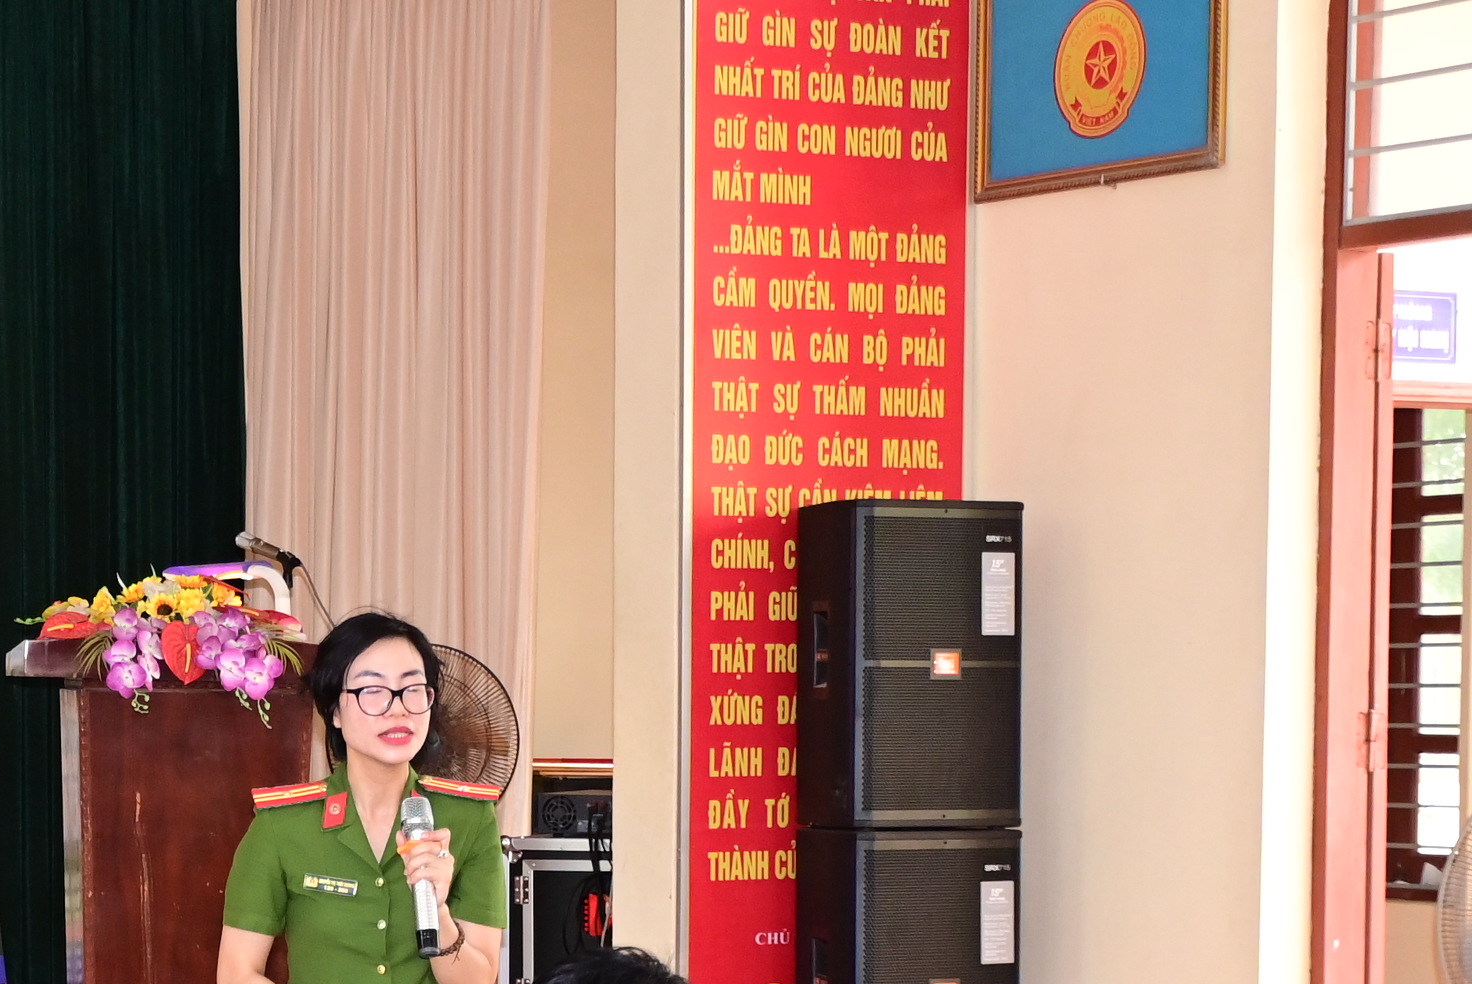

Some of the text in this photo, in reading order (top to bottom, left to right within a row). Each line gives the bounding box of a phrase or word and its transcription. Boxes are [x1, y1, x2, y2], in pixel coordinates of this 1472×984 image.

[715, 7, 950, 59] GIỮ GÌN SỰ ĐOÀN KẾT
[714, 56, 951, 111] NHẤT TRÍ CỦA ĐẢNG NHƯ
[713, 116, 948, 163] GIỮ GÌN CON NGƯƠI CỦA
[712, 161, 811, 206] MẮT MÌNH
[790, 227, 811, 258] TA
[818, 222, 842, 260] LÀ
[848, 225, 889, 267] MỘT
[895, 224, 947, 265] ĐẢNG
[712, 264, 946, 318] CẦM QUYỀN. MỌI ĐẢNG
[712, 323, 946, 373] VIÊN VÀ CÁN BỘ PHẢI
[711, 373, 945, 421] THẬT SỰ THẤM NHUẦN
[711, 424, 944, 476] ĐẠO ĐỨC CÁCH MẠNG.
[711, 480, 793, 525] THẬT SỰ
[711, 533, 774, 573] CHÍNH,
[710, 581, 754, 622] PHẢI
[709, 637, 756, 680] THẬT
[709, 689, 763, 726] XỨNG
[709, 741, 763, 778] LÃNH
[708, 788, 790, 829] ĐẦY TỚ
[708, 840, 797, 881] THÀNH CỦ
[755, 928, 791, 945] CHỦ
